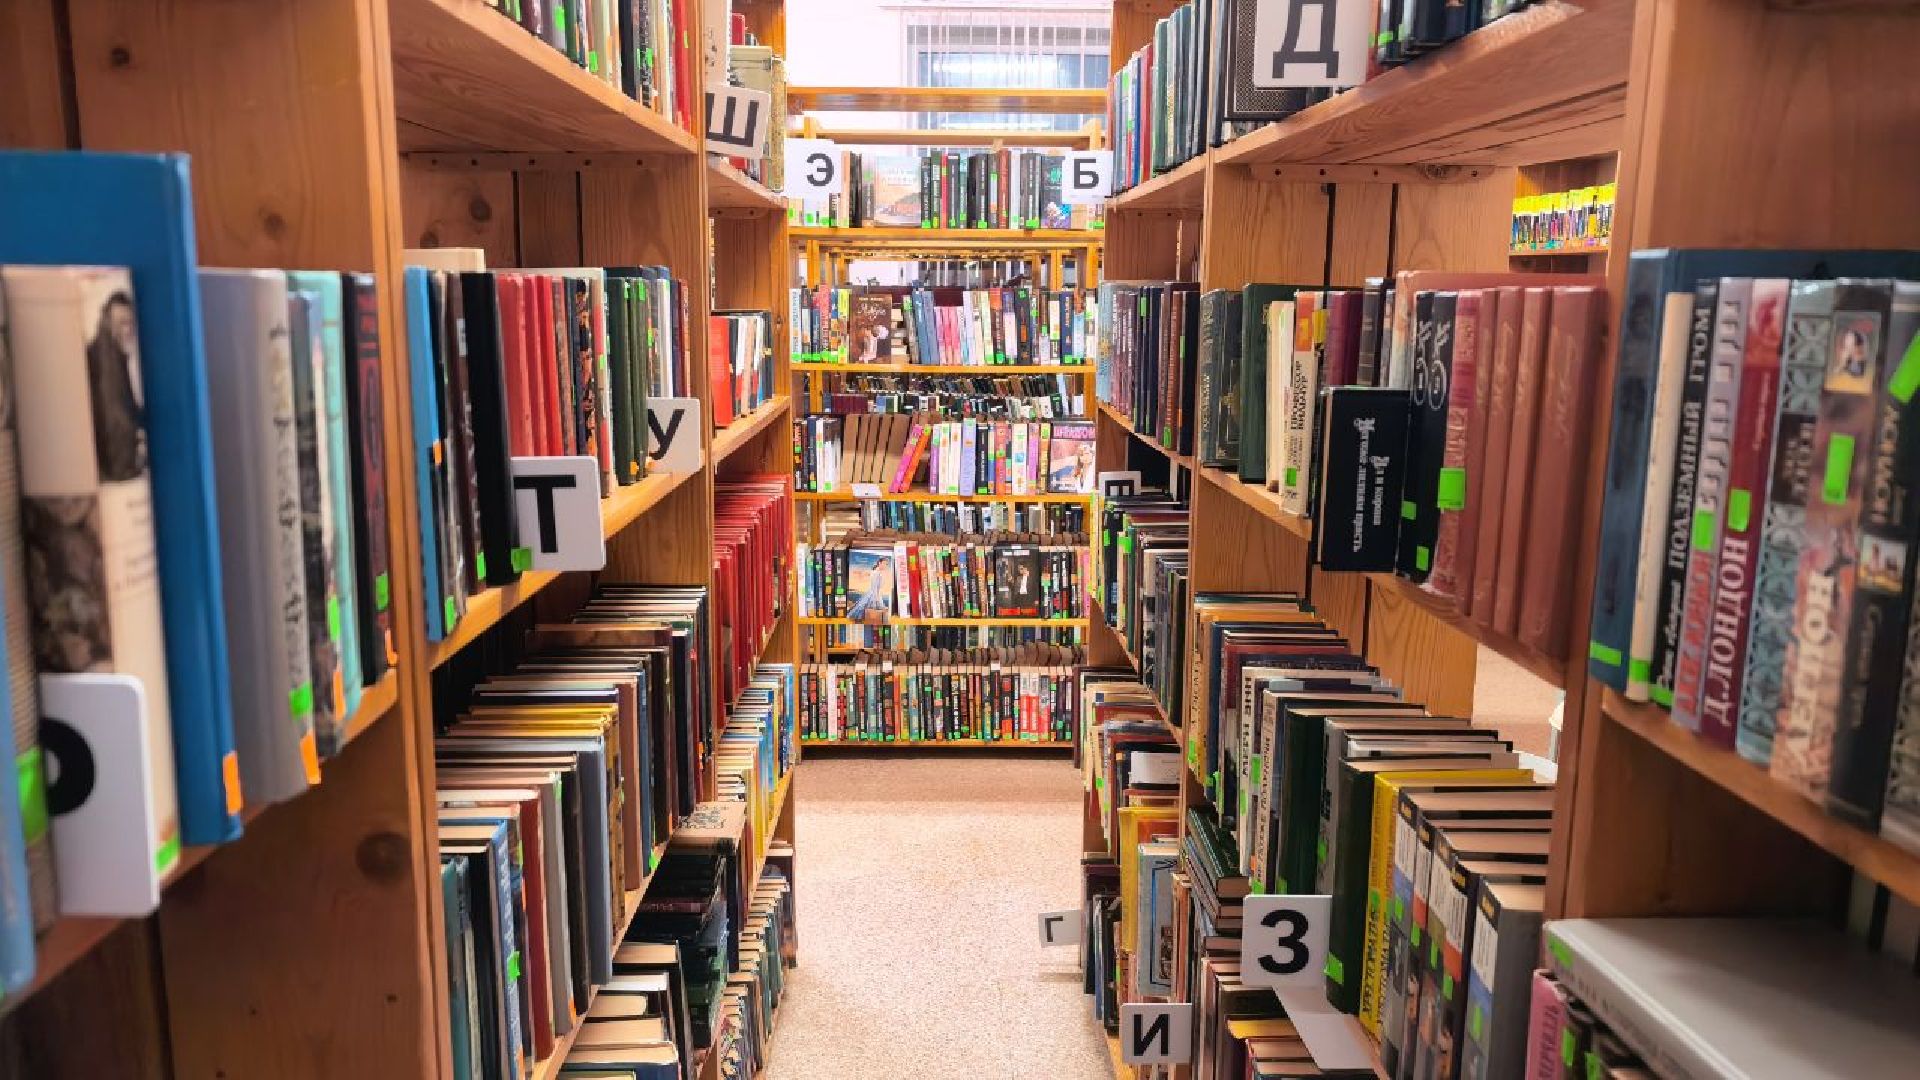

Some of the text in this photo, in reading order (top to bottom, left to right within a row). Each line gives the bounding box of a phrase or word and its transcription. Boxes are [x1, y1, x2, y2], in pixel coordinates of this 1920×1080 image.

[1271, 0, 1340, 79] Д
[704, 92, 760, 148] Ш
[805, 152, 835, 188] Э
[1073, 158, 1100, 190] Б
[647, 408, 685, 460] У
[1667, 402, 1701, 568] ПОДЗЕМНЫЙ
[1688, 308, 1711, 382] ГРОМ
[513, 474, 577, 553] Т
[1704, 536, 1749, 727] Д.ЛОНДОН
[1045, 915, 1064, 943] Г
[1257, 909, 1310, 974] З
[1133, 1013, 1171, 1057] И
